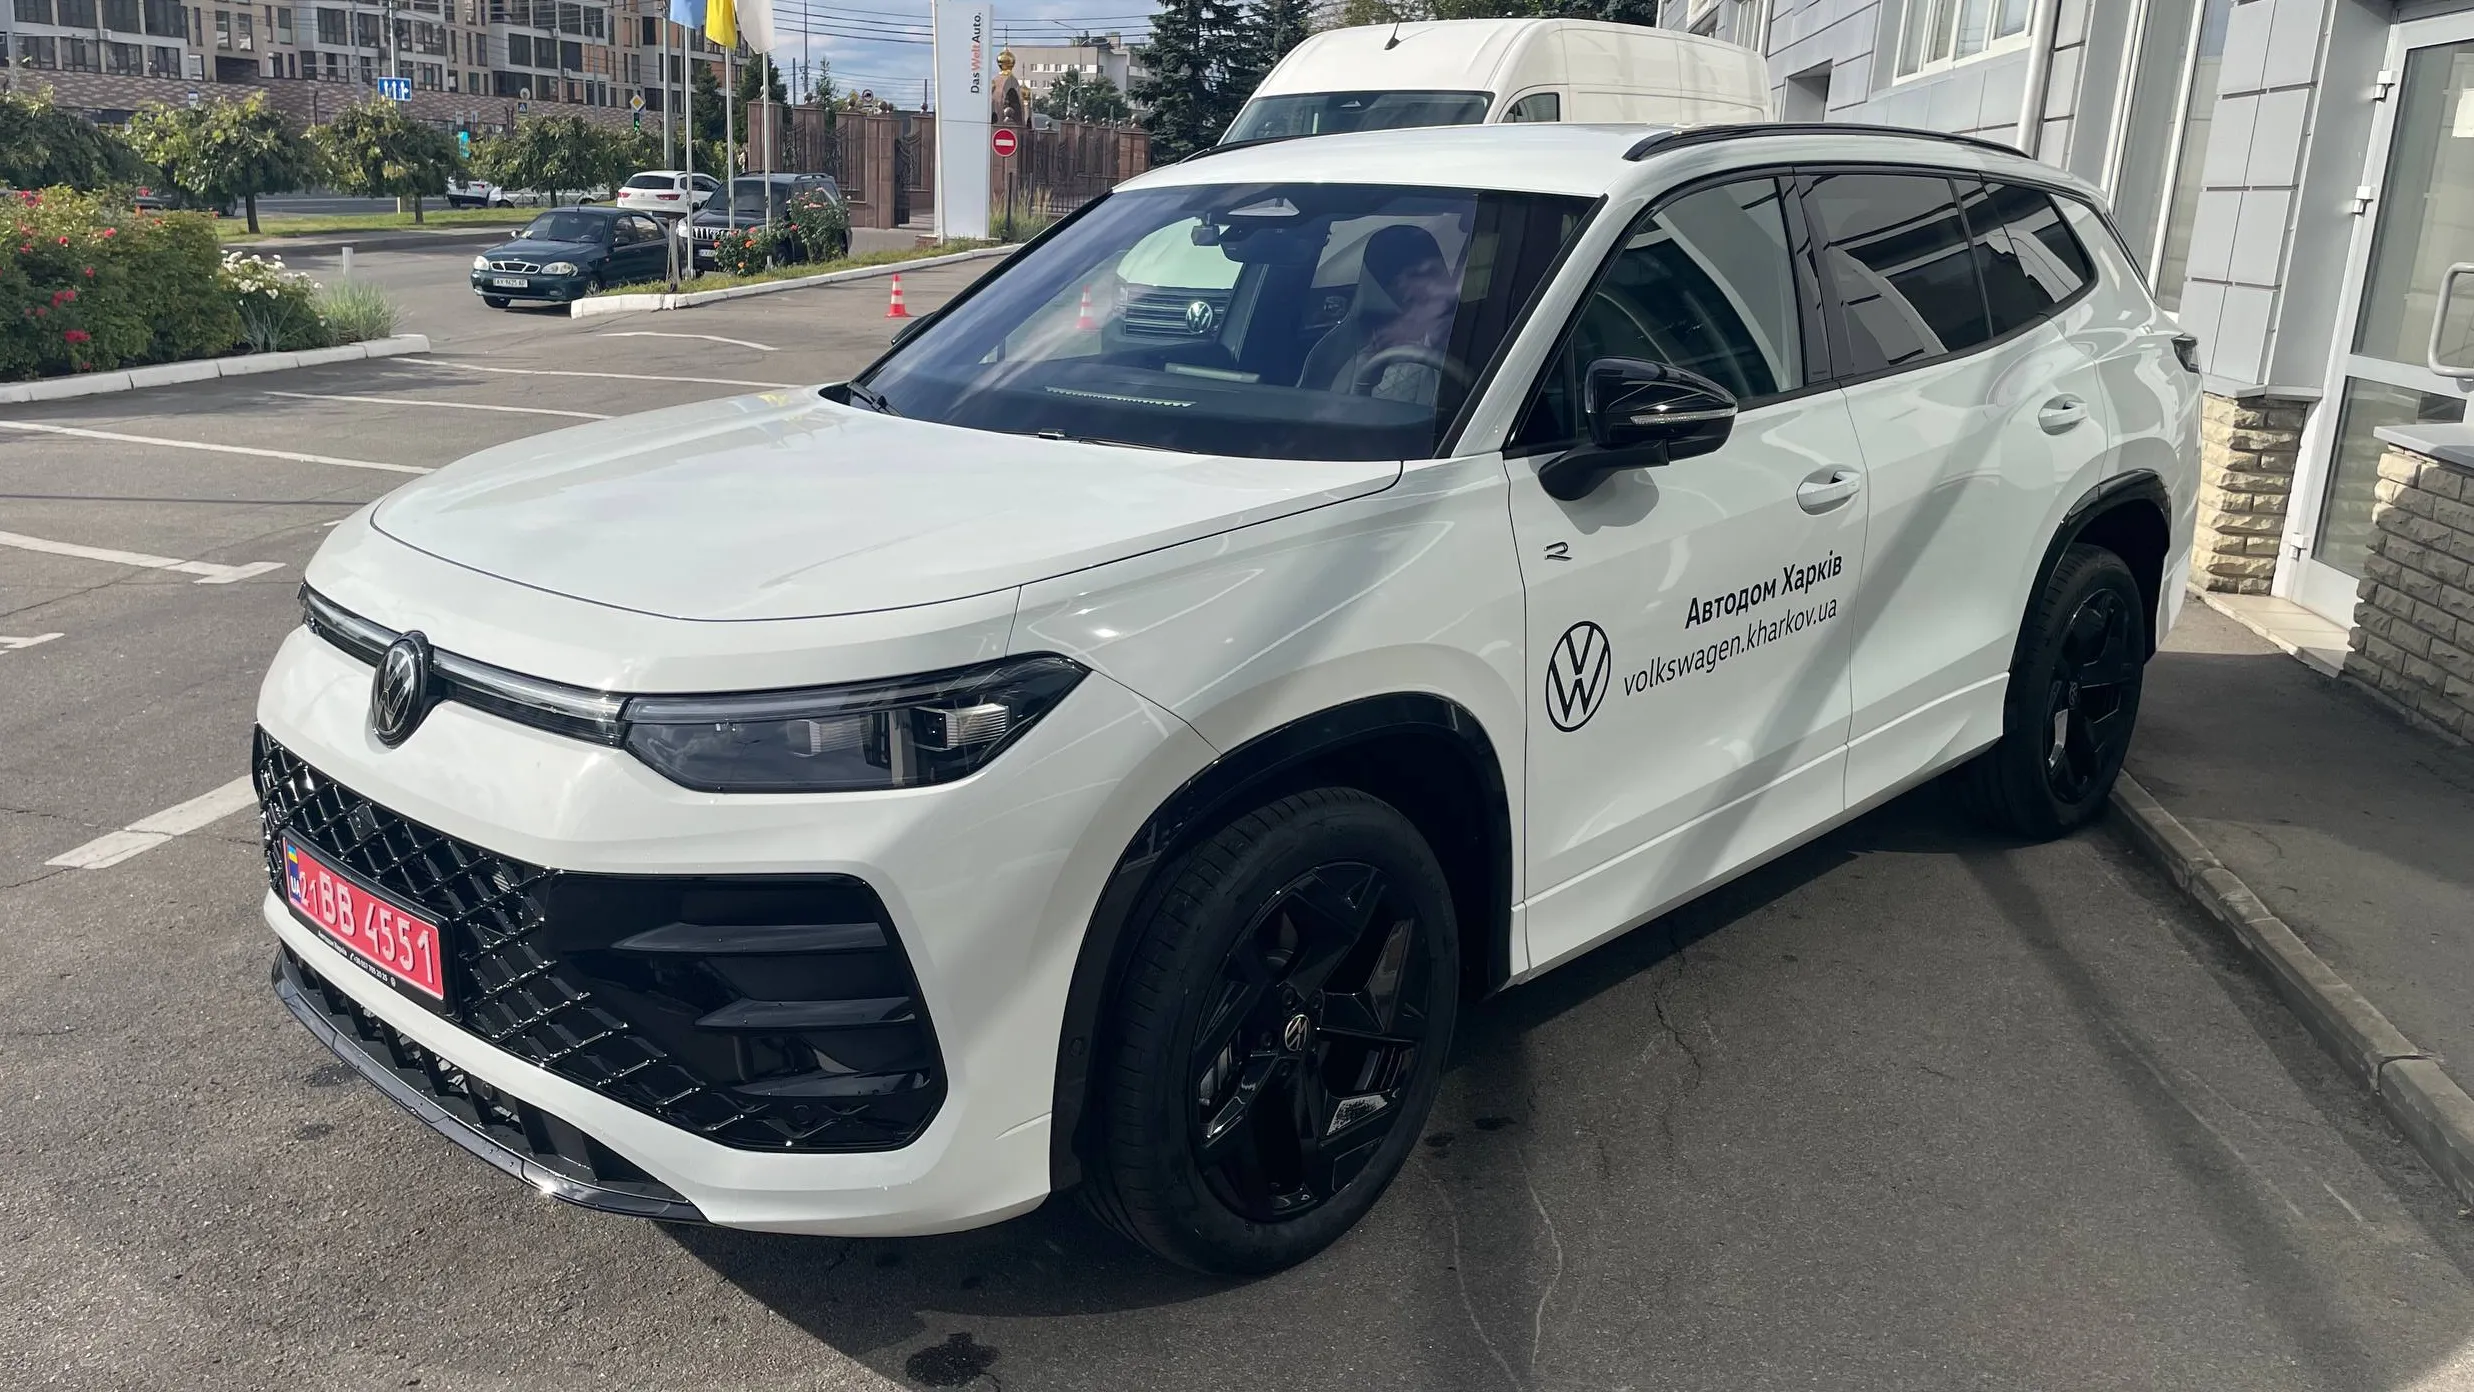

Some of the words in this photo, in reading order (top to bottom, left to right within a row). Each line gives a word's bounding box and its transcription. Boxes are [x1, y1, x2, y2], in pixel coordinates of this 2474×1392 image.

[972, 12, 982, 43] Auto.
[971, 44, 981, 71] Welt
[970, 72, 980, 94] Das
[1684, 578, 1777, 629] Автодом
[1781, 550, 1843, 594] Харків
[1624, 599, 1838, 697] volkswagen.kharkov.ua
[290, 875, 300, 898] UA
[364, 902, 434, 984] 4551
